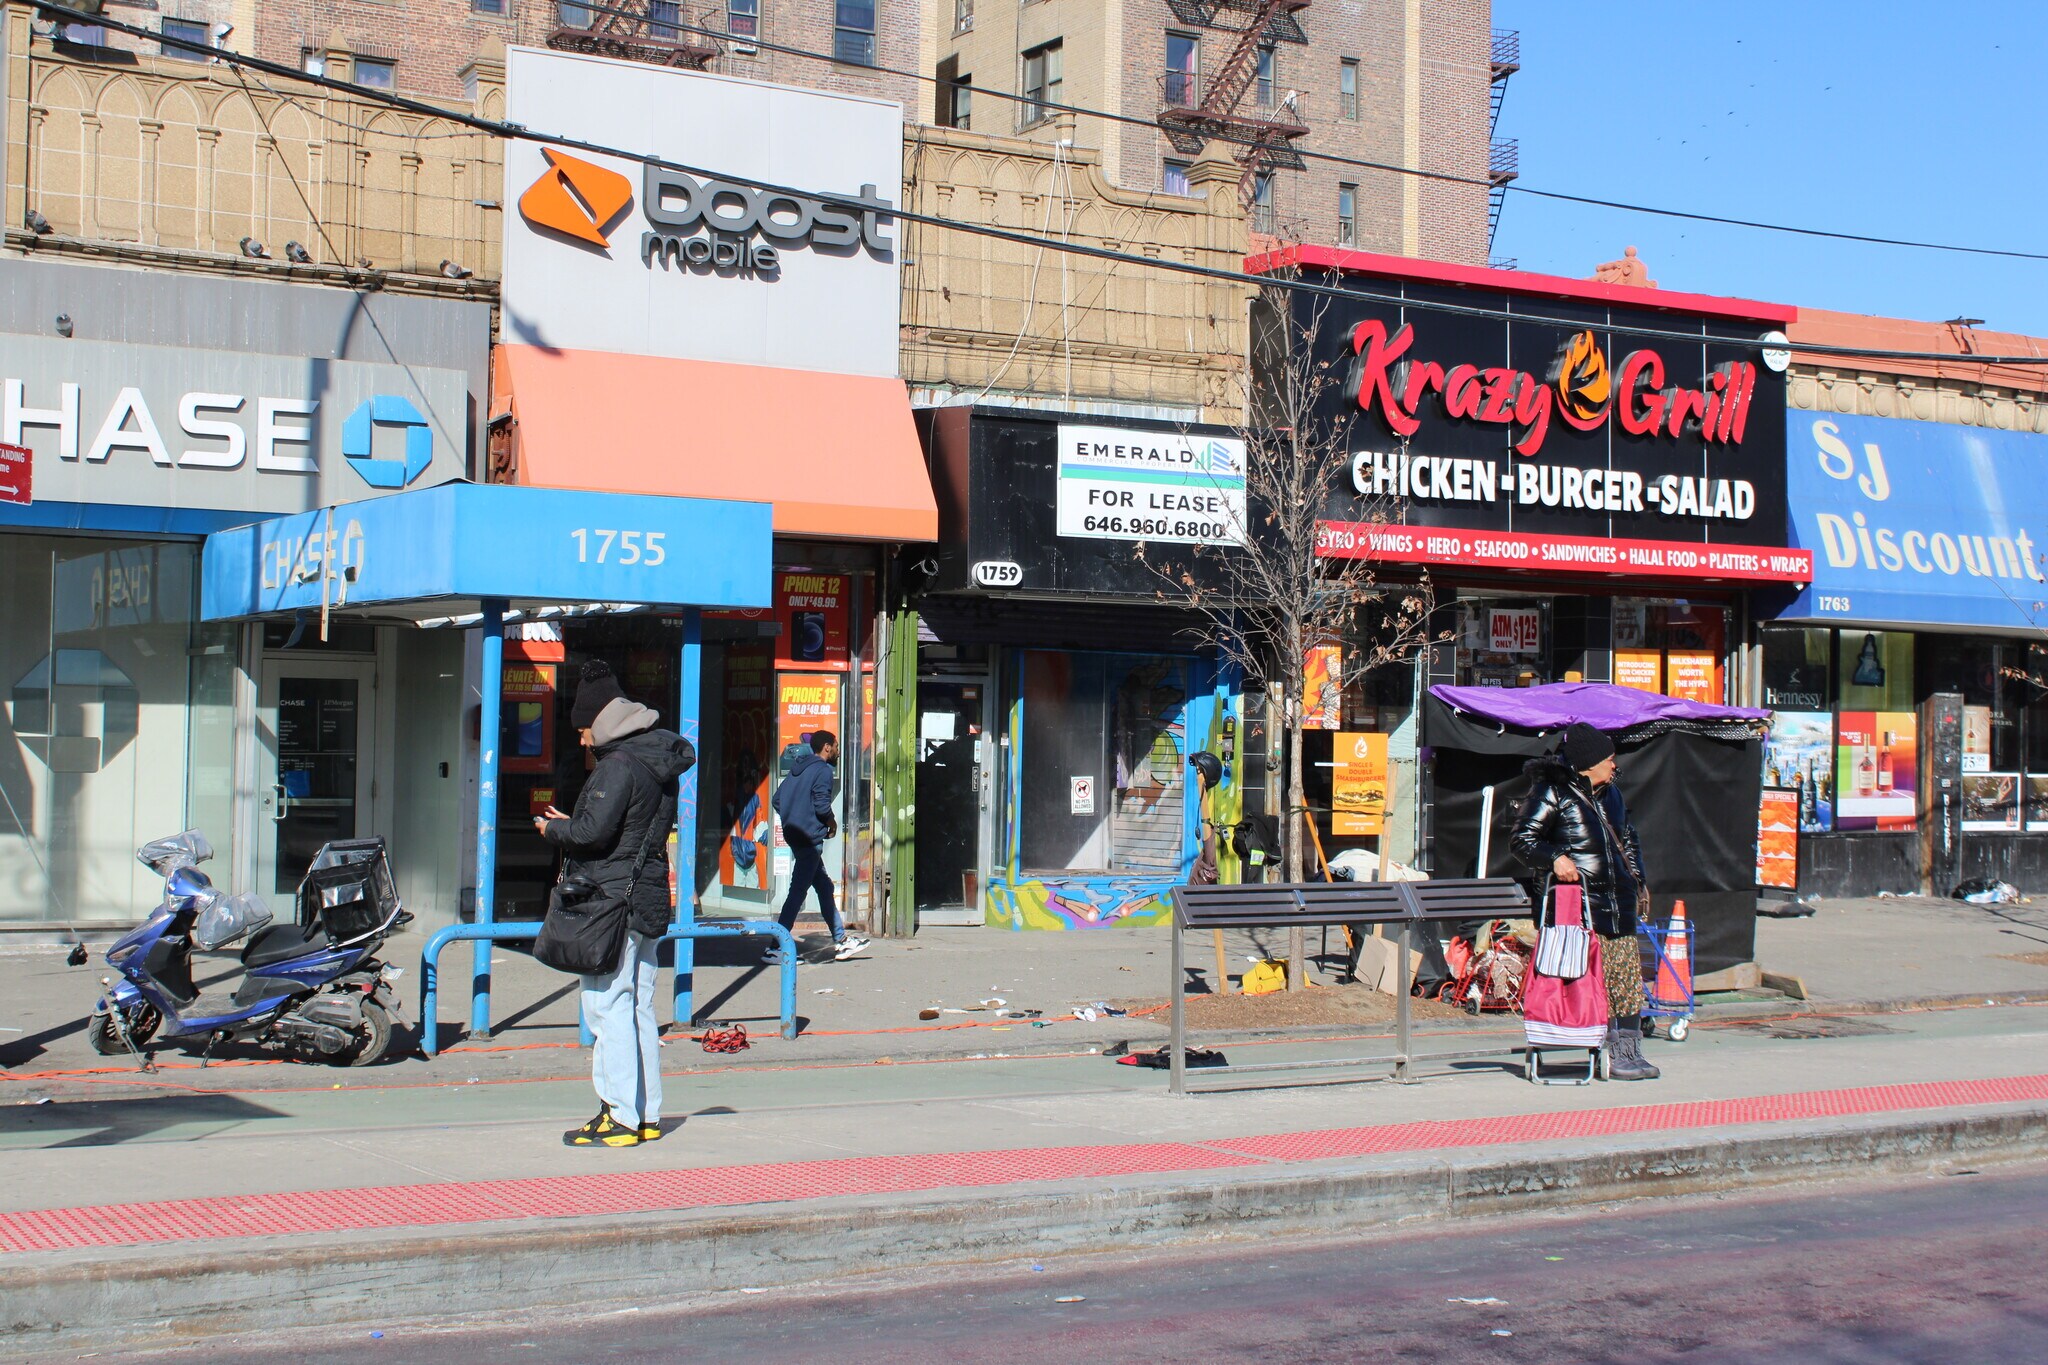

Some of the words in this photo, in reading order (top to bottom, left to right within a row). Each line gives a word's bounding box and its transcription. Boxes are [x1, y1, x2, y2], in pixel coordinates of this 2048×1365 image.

[643, 155, 893, 251] boost
[642, 232, 780, 271] mobile
[1353, 320, 1551, 456] Krazy
[1619, 349, 1756, 444] Grill
[4, 378, 320, 472] HASE
[0, 448, 25, 463] ANDING
[1077, 442, 1193, 463] EMERALD
[1077, 456, 1133, 466] COMMERCIAL
[1140, 460, 1191, 469] PROPERTIES
[1089, 489, 1134, 508] FOR
[1150, 493, 1219, 513] LEASE
[1084, 515, 1224, 538] 646.960.6800
[571, 528, 666, 566] 1755
[1317, 531, 1355, 550] GYRO
[1369, 534, 1413, 553] WINGS
[1427, 537, 1461, 556] HERO
[1474, 539, 1528, 559] SEAFOOD
[1542, 543, 1616, 564] SANDWICHES
[1629, 548, 1664, 566] HALAL
[1667, 551, 1697, 568] FOOD
[1709, 555, 1758, 571] PLATTERS
[1770, 556, 1809, 574] WRAPS
[1816, 511, 2046, 582] Discount
[981, 566, 1018, 581] 1759
[783, 576, 826, 594] iPHONE
[827, 577, 841, 595] 12
[788, 595, 809, 607] ONLY
[809, 596, 836, 608] $49.99
[1818, 596, 1850, 612] 1763
[1492, 614, 1512, 637] ATM
[1495, 640, 1512, 648] ONLY
[1670, 657, 1712, 665] MILKSHAKES
[503, 668, 534, 683] LÉVATE
[535, 671, 549, 684] UN
[1678, 669, 1704, 677] WORTH
[1688, 680, 1708, 688] HYPE!
[781, 687, 822, 703] iPHONE
[824, 688, 837, 704] 13
[1766, 687, 1822, 709] Hennessy
[788, 704, 806, 715] SOLO
[1336, 774, 1385, 782] SMASHBURGERS
